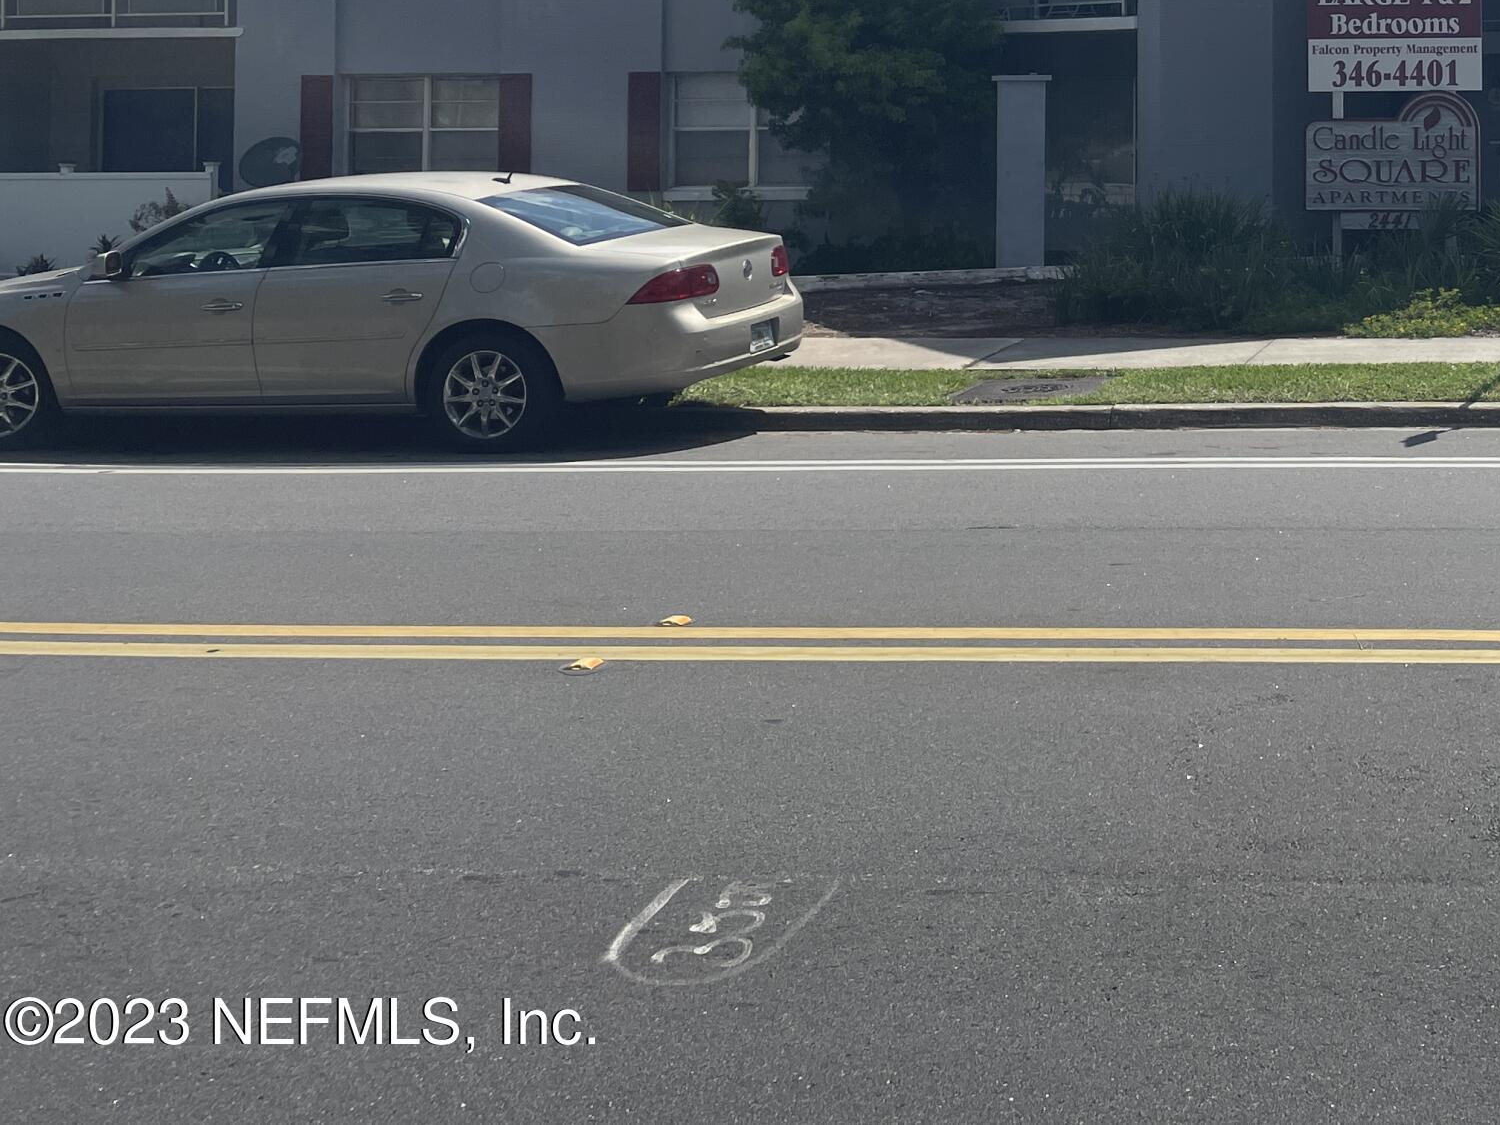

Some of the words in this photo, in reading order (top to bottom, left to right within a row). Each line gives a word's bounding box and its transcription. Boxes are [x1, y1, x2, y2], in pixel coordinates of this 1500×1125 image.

[1330, 13, 1460, 35] Bedrooms
[1312, 44, 1349, 55] Falcon
[1353, 44, 1402, 57] Property
[1406, 43, 1478, 56] Management
[1331, 59, 1459, 88] 346-4401
[1313, 126, 1400, 151] Candle
[1412, 126, 1470, 159] Light
[1312, 159, 1470, 186] SQUARE
